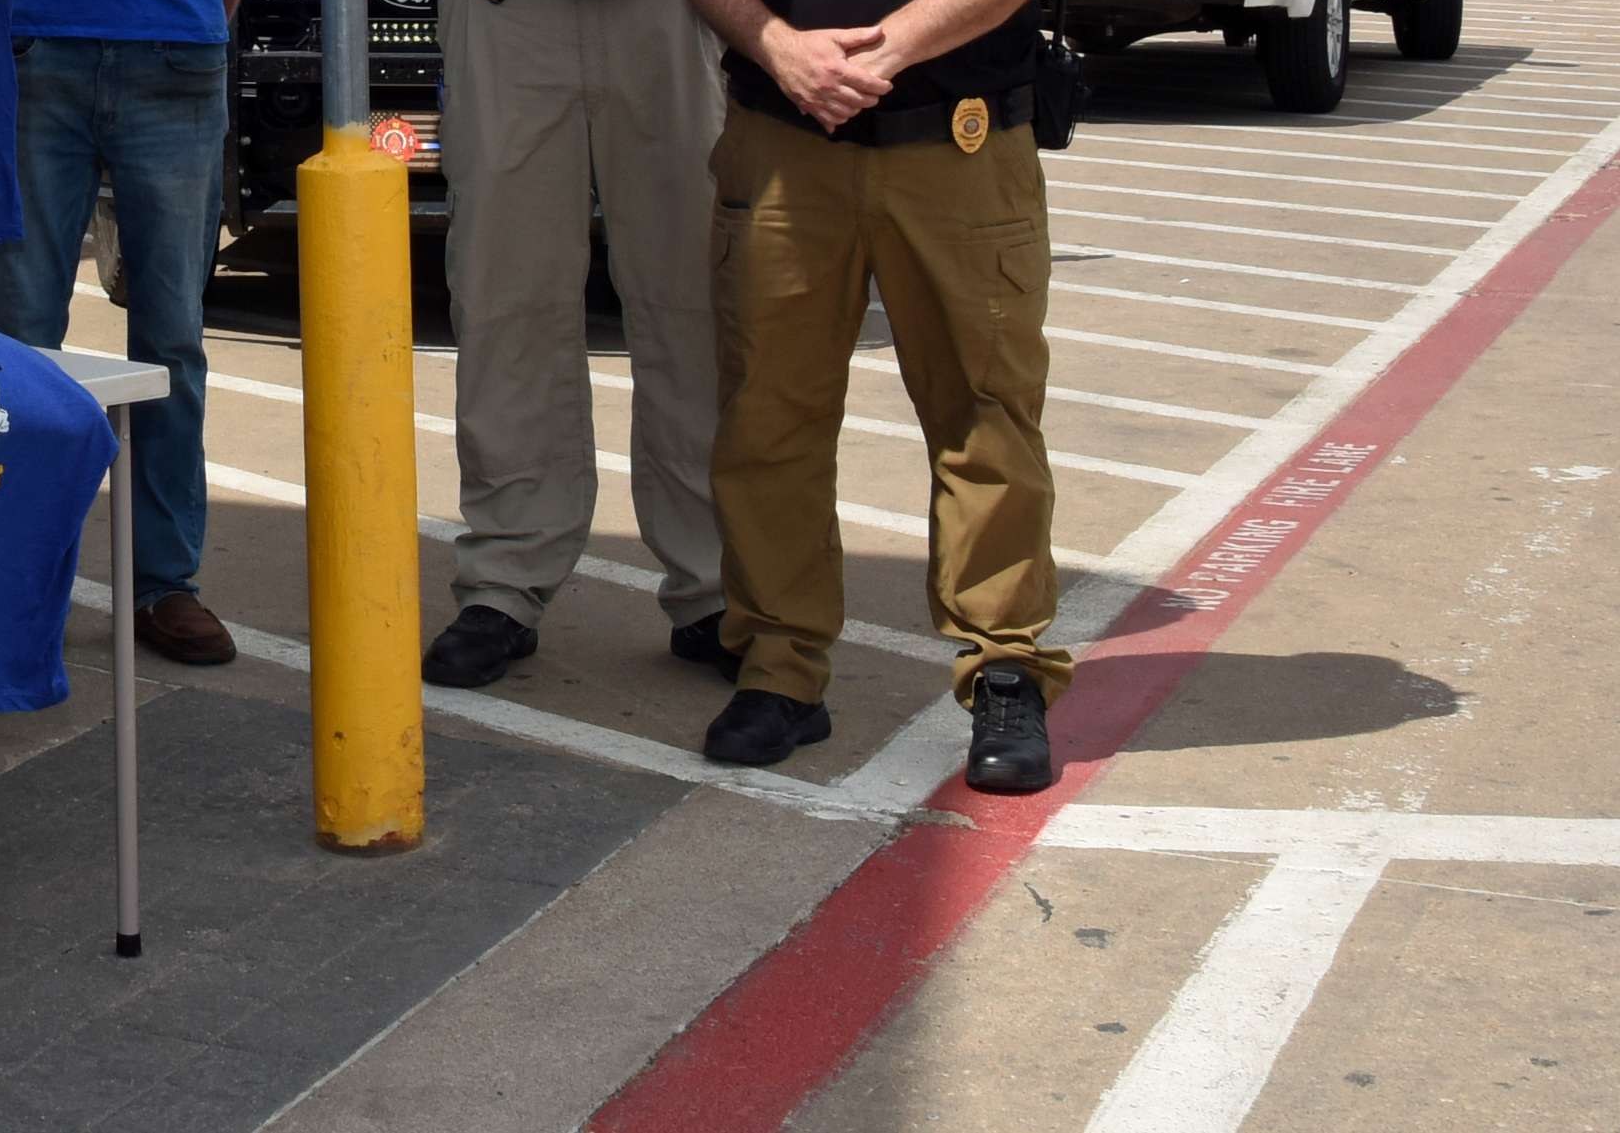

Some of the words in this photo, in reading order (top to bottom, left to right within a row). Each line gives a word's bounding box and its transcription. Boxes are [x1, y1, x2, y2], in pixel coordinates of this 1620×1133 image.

[1297, 442, 1378, 474] LANE
[1260, 476, 1341, 508] FIRE
[1188, 518, 1301, 584] PARKING
[1160, 587, 1231, 611] NO
